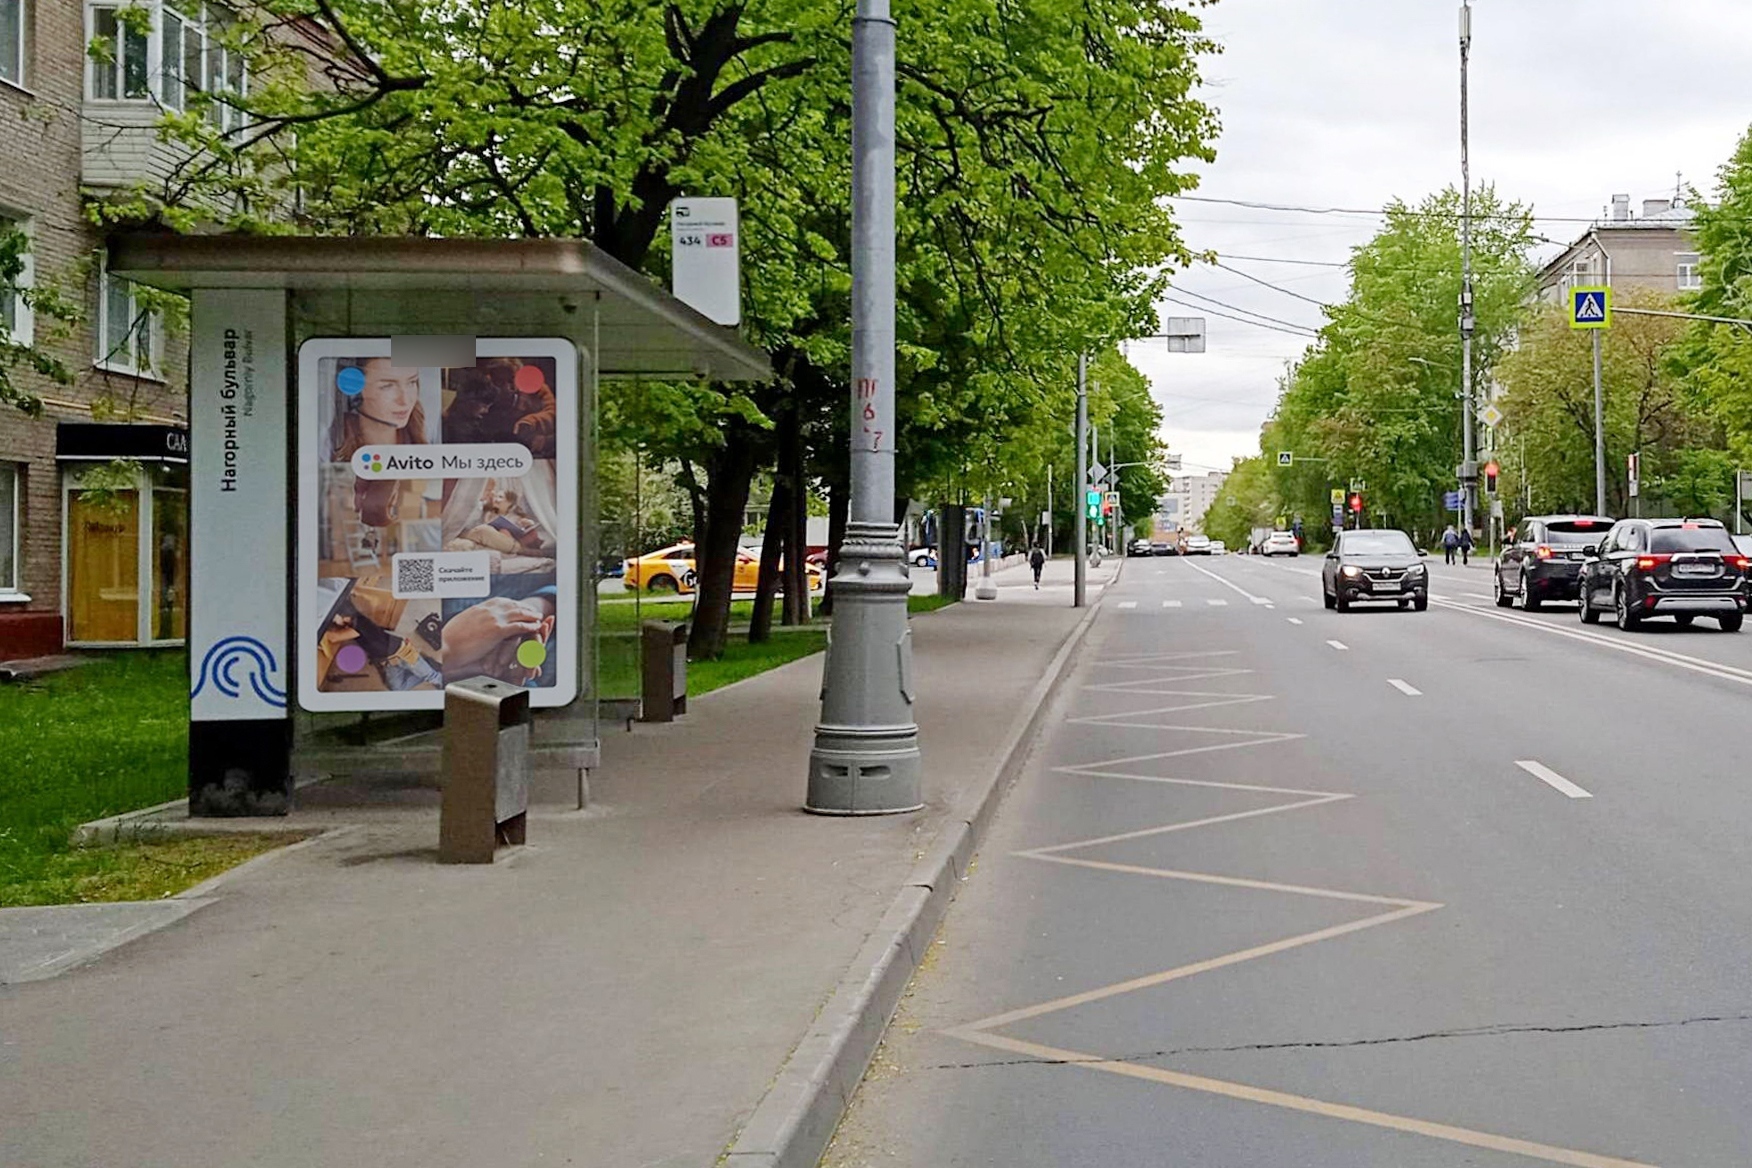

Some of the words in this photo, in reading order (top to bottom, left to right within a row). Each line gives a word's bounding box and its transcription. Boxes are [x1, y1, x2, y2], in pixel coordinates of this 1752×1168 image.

[679, 236, 701, 246] 434
[220, 328, 240, 399] бульвар
[220, 405, 240, 492] Нагорный
[386, 455, 434, 470] Avito
[442, 455, 472, 470] Мы
[476, 457, 524, 472] здесь
[438, 566, 473, 574] Скачайте
